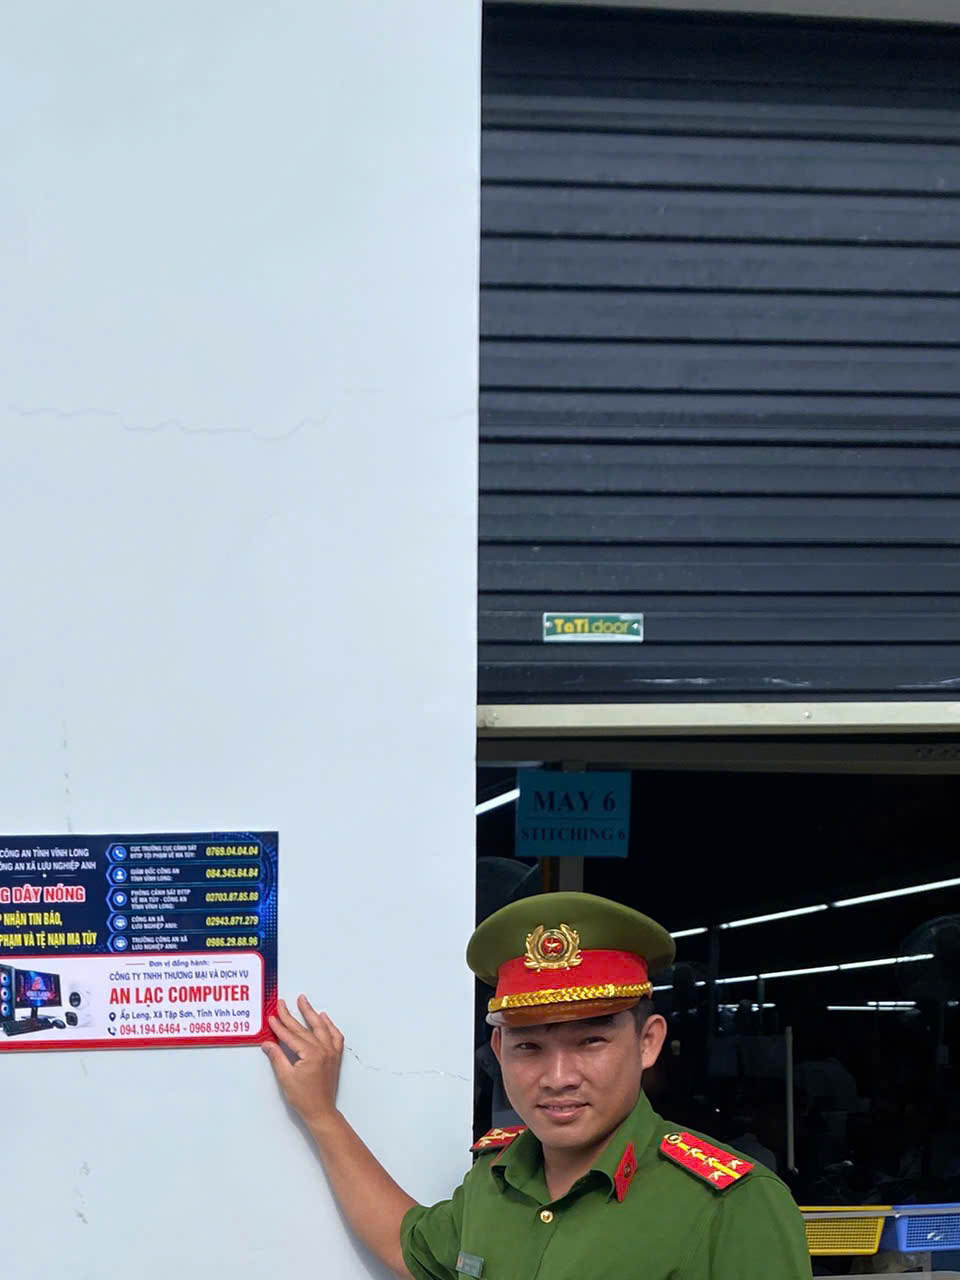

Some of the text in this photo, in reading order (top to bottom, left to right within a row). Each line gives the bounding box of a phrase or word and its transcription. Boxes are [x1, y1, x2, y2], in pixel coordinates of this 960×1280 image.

[591, 619, 630, 633] door
[532, 787, 617, 812] MAY 6
[521, 827, 627, 840] STITCHING 6
[21, 849, 32, 857] AN
[69, 848, 90, 857] LONG
[14, 862, 25, 870] AN
[26, 861, 37, 870] XÃ
[52, 860, 80, 871] NGHIỆP
[81, 861, 97, 869] ANH
[12, 884, 42, 903] DÂY
[44, 883, 85, 902] NÓNG
[3, 911, 27, 928] NHẬN
[28, 913, 42, 925] TIN
[43, 910, 63, 926] BÁO,
[23, 931, 35, 946] VÀ
[47, 932, 65, 948] NẠN
[66, 932, 81, 946] MA
[172, 959, 189, 967] đồng
[109, 968, 249, 981] CÔNG TY TNHH THƯƠNG MẠI VÀ DỊCH VỤ
[109, 984, 250, 1008] AN LẠC COMPUTER
[153, 1010, 162, 1018] Xã
[164, 1010, 178, 1019] Tập
[179, 1009, 195, 1018] Sơn,
[197, 1009, 212, 1017] Tỉnh
[214, 1009, 231, 1017] Vĩnh
[231, 1008, 250, 1018] Long
[119, 1023, 181, 1035] 094.194.6464
[189, 1021, 250, 1033] 0968.932.919
